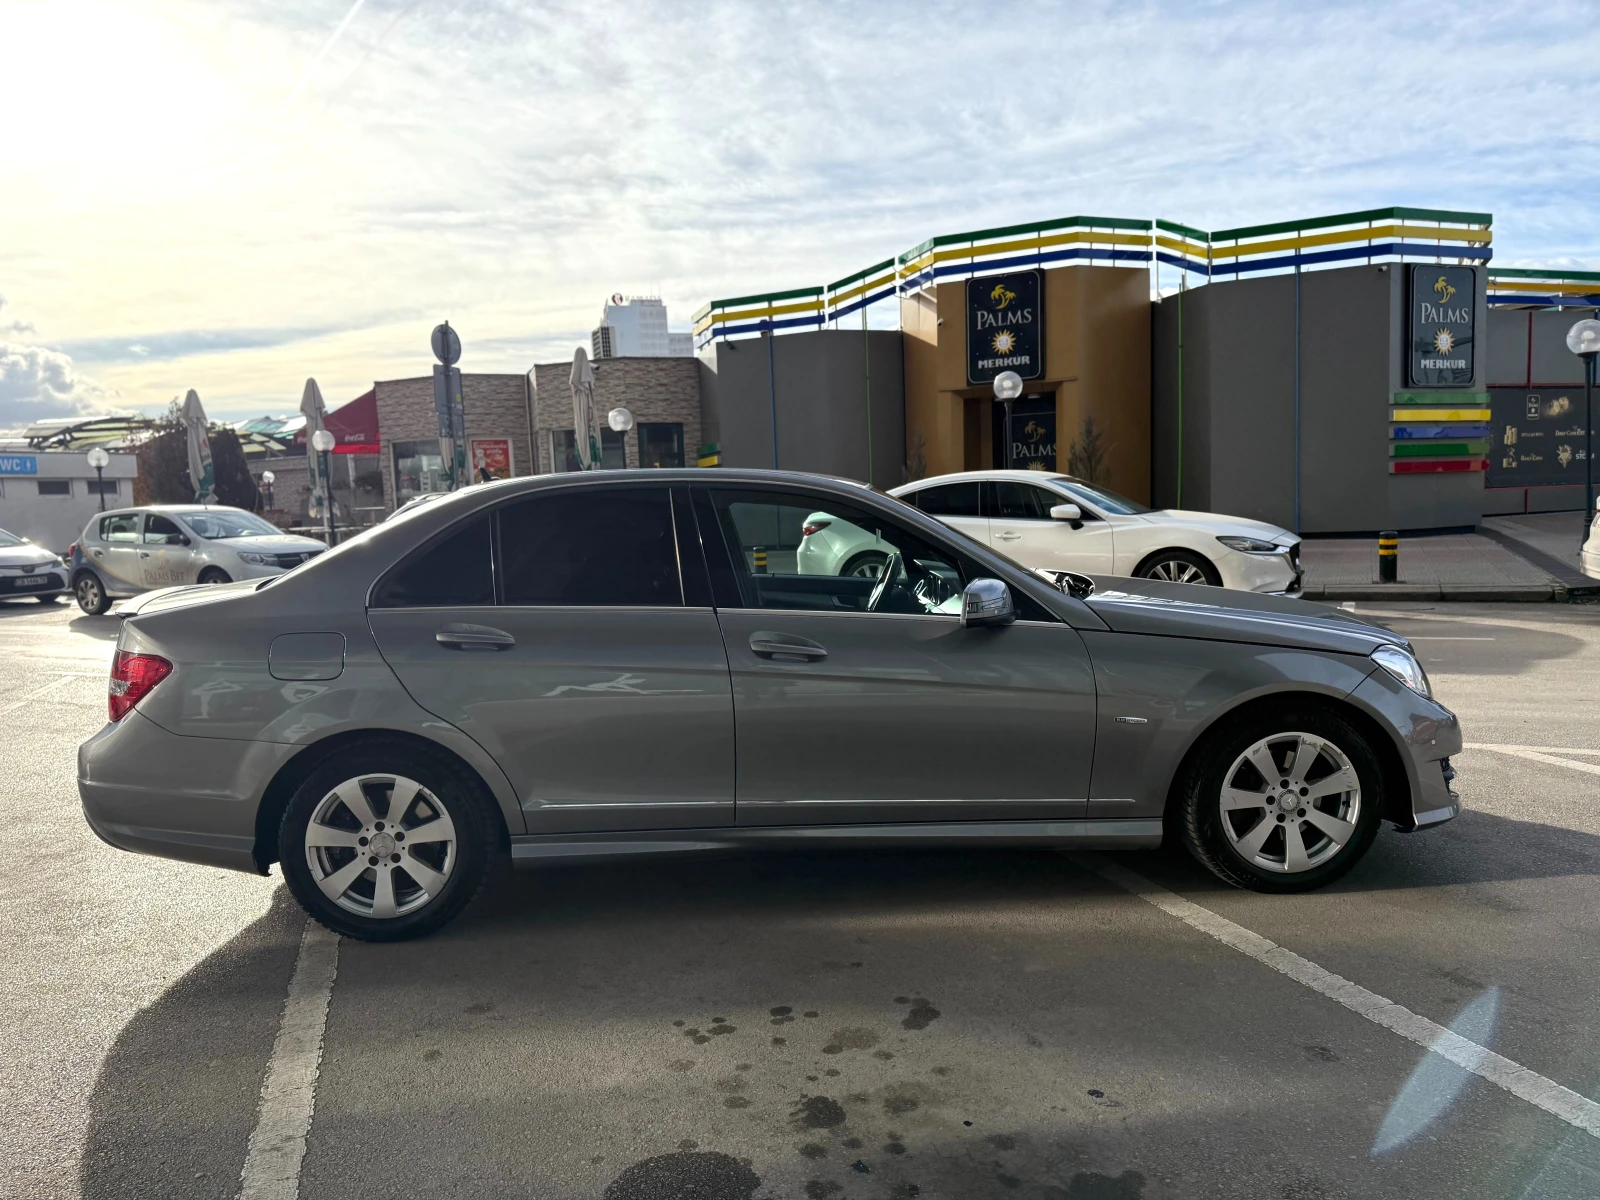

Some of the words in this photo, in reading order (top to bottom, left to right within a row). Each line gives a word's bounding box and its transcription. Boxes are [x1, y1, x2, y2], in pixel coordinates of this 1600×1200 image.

[976, 308, 1033, 330] PALMS
[1420, 302, 1469, 324] PALMS
[977, 355, 1031, 369] MERKUR
[1420, 359, 1466, 369] MERKUR
[0, 458, 21, 471] WC
[143, 569, 169, 581] PALMS
